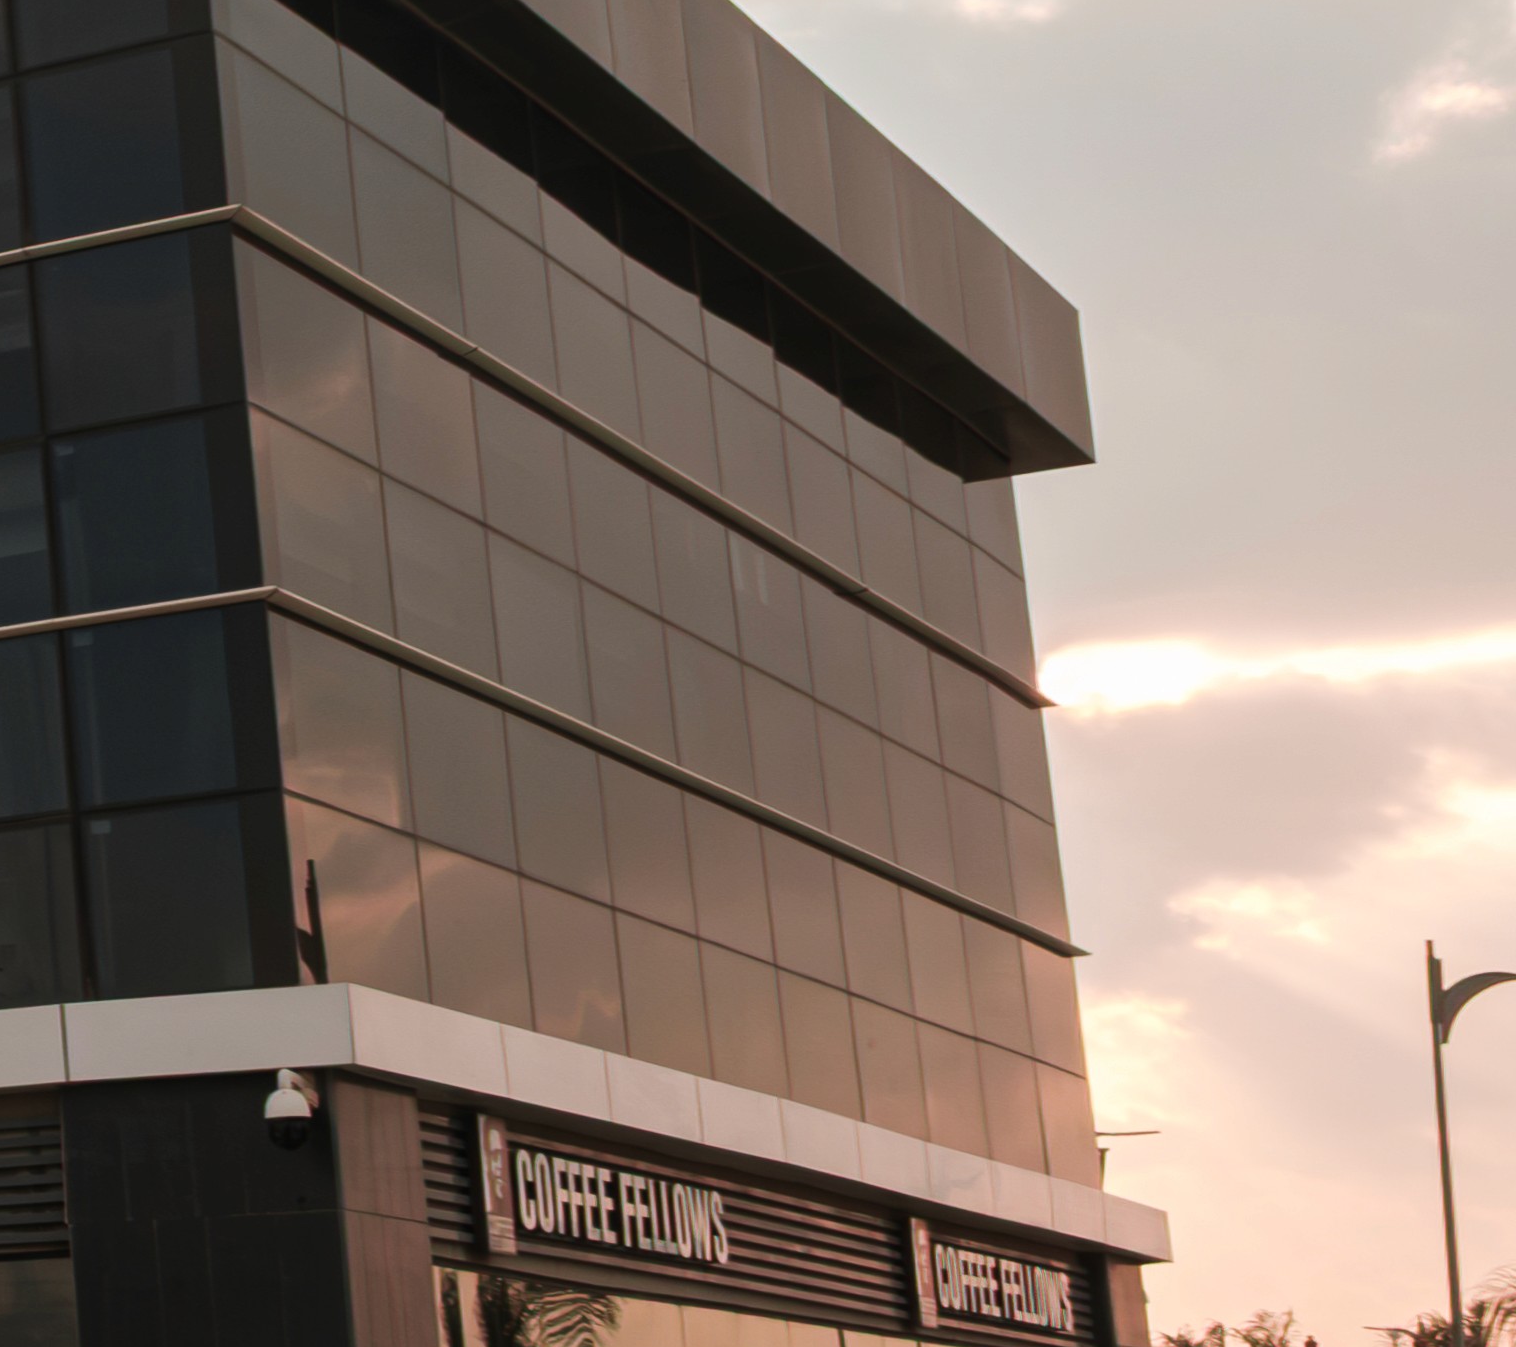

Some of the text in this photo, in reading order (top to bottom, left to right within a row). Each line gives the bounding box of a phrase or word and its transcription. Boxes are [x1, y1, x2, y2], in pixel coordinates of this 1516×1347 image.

[515, 1149, 617, 1245] COFFEE
[618, 1172, 729, 1264] FELLOWS
[935, 1243, 1001, 1317] COFFEE
[1001, 1259, 1074, 1332] FELLOWS
